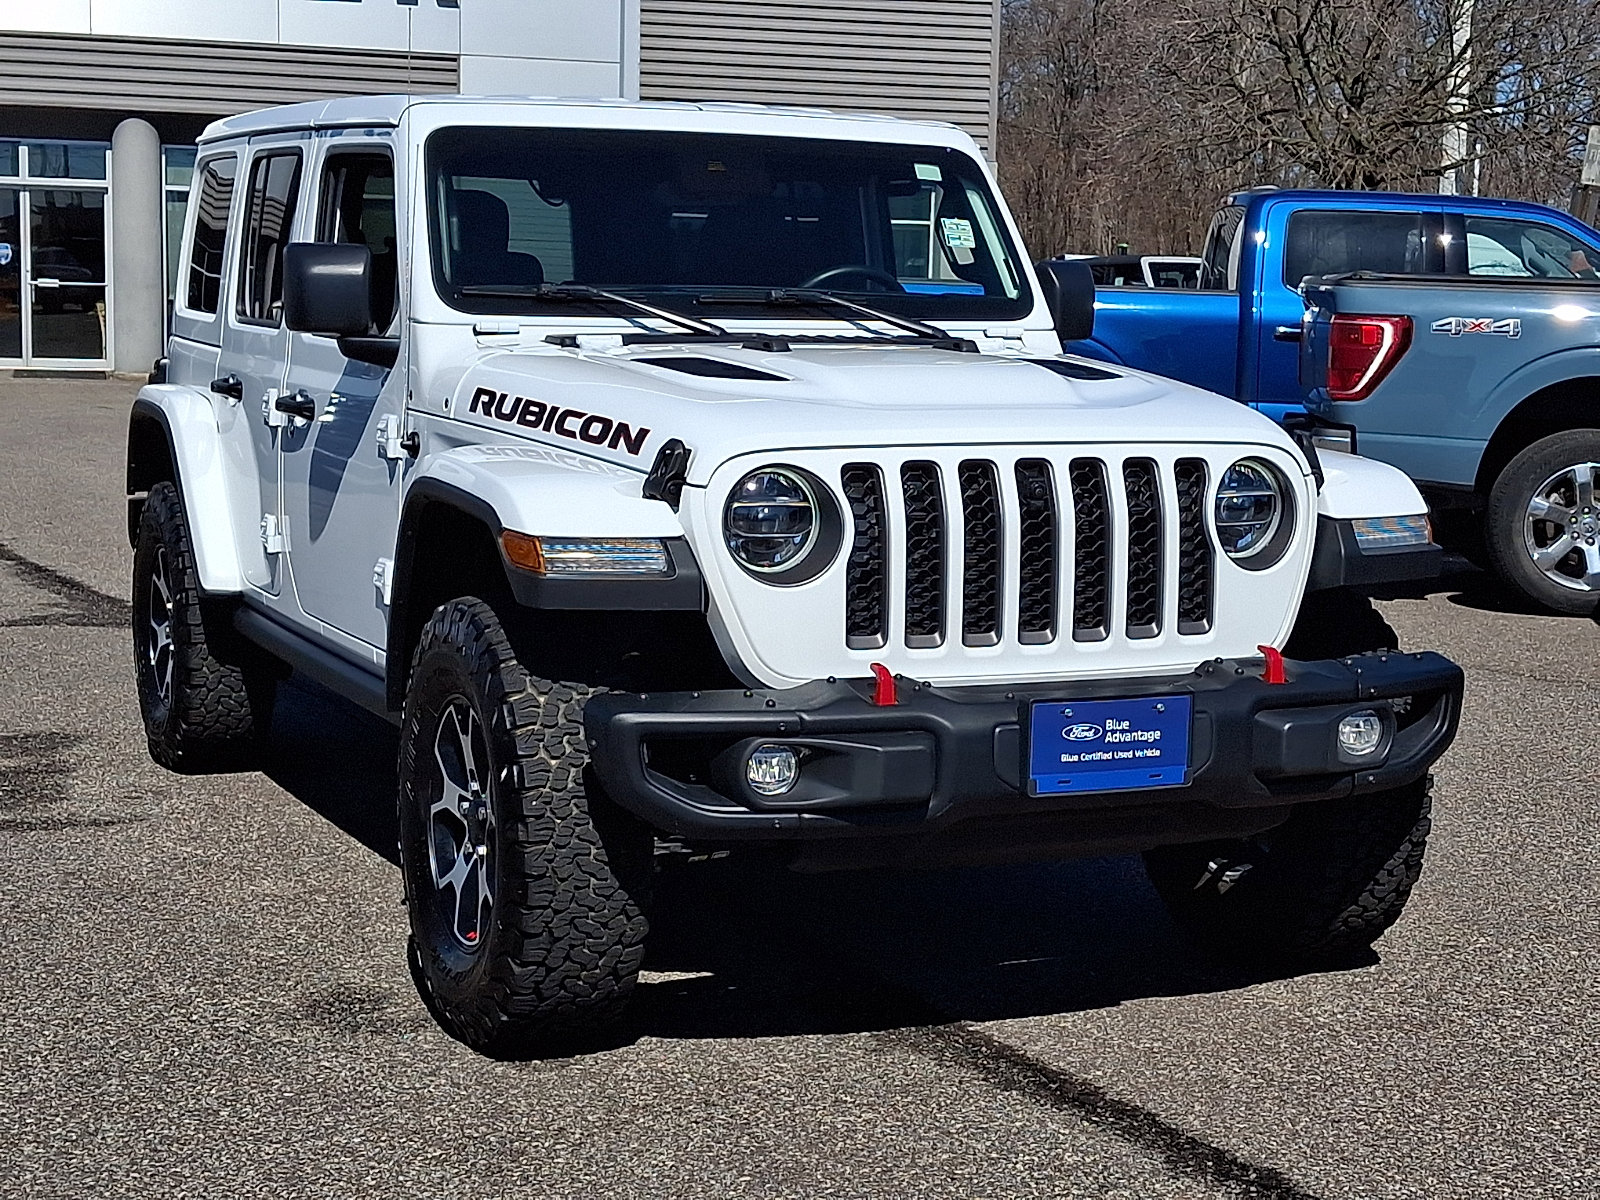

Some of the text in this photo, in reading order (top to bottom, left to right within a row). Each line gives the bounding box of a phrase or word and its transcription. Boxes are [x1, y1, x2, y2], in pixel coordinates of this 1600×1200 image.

[469, 387, 651, 456] RUBICON
[1105, 719, 1130, 731] Blue
[1105, 730, 1161, 743] Advantage
[1061, 748, 1161, 762] Blue Certified Used Vehicle
